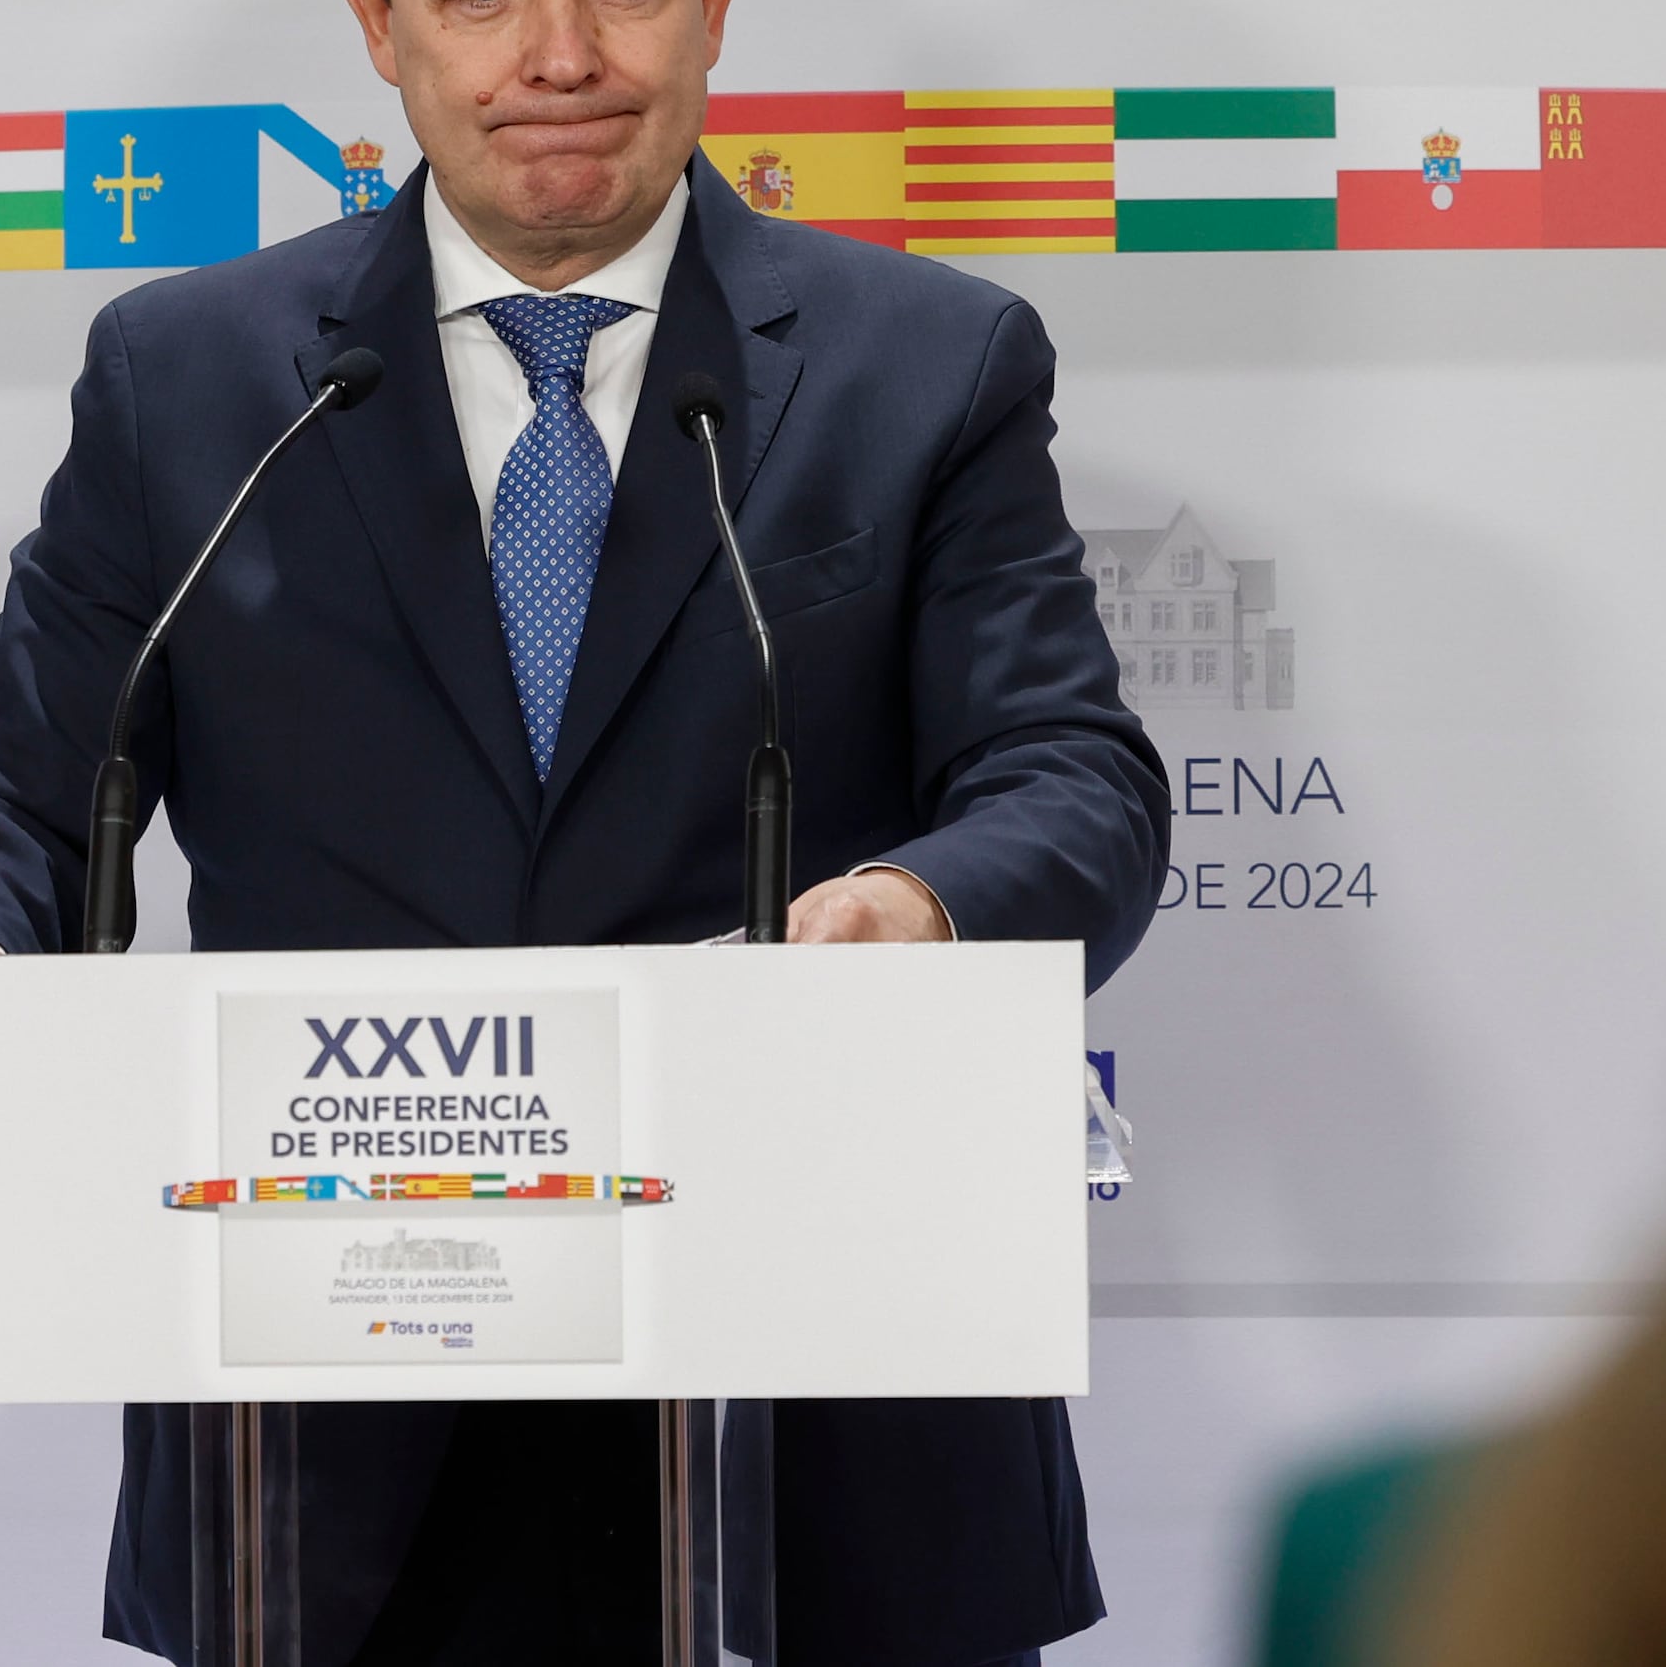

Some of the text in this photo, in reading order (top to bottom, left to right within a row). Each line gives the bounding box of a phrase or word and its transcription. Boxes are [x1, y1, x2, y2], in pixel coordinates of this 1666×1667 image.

[1247, 862, 1378, 910] 2024
[304, 1016, 534, 1079] XXVII
[289, 1094, 550, 1123] CONFERENCIA
[271, 1129, 569, 1157] DE PRESIDENTES
[333, 1276, 509, 1290] PALACIO DE LA MAGDALENA
[405, 1294, 418, 1304] DE
[420, 1294, 474, 1304] DICIEMBRE
[476, 1294, 490, 1304] DE
[388, 1321, 474, 1335] Tots a una
